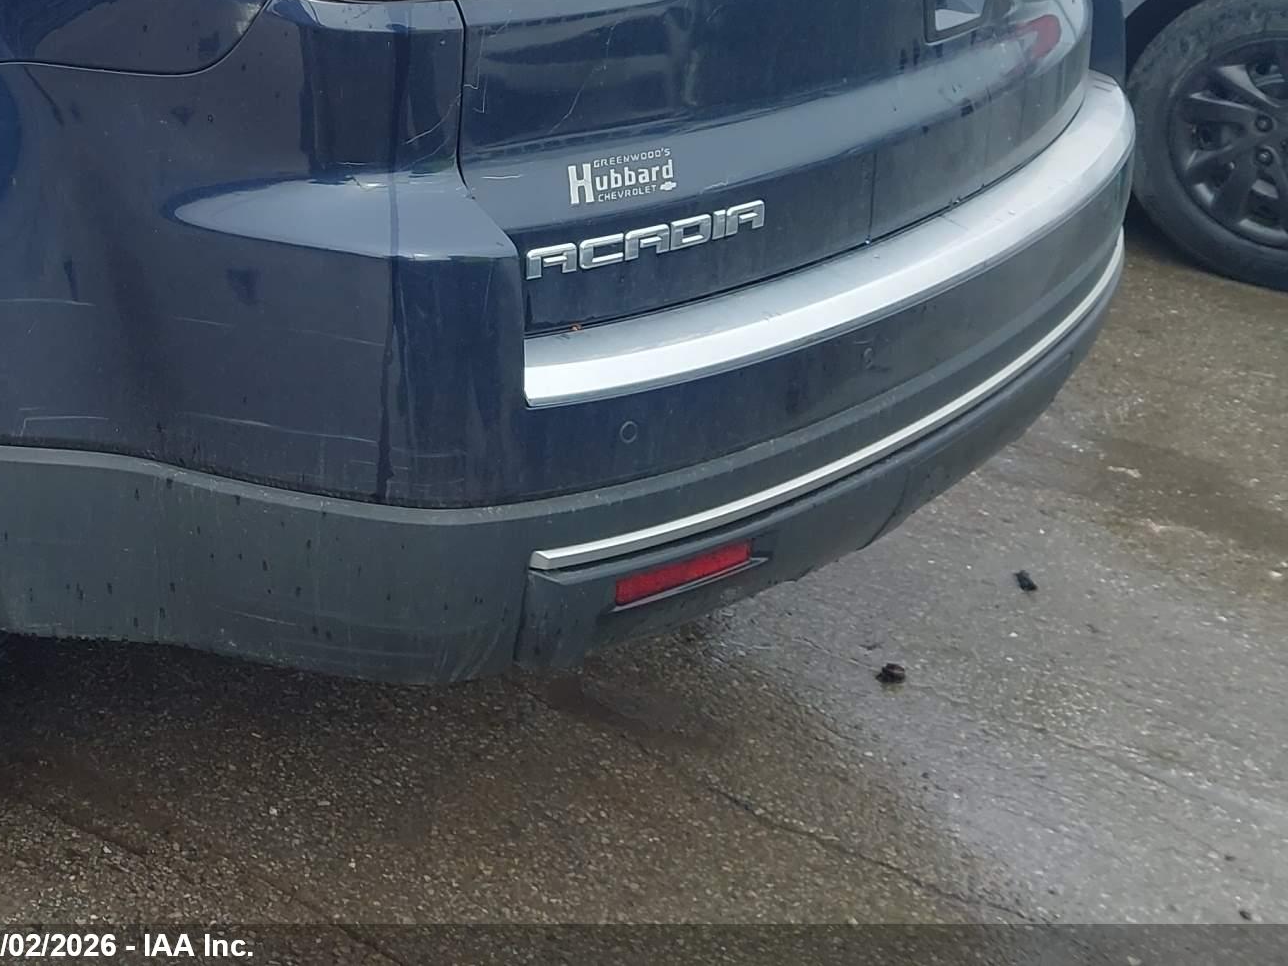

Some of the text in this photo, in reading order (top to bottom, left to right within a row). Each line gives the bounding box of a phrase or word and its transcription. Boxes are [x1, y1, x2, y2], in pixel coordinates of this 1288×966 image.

[593, 147, 671, 168] GREENWOOD'S
[568, 159, 674, 204] Hubbard
[598, 184, 657, 202] CHEVROLET
[525, 200, 765, 280] ACADIA
